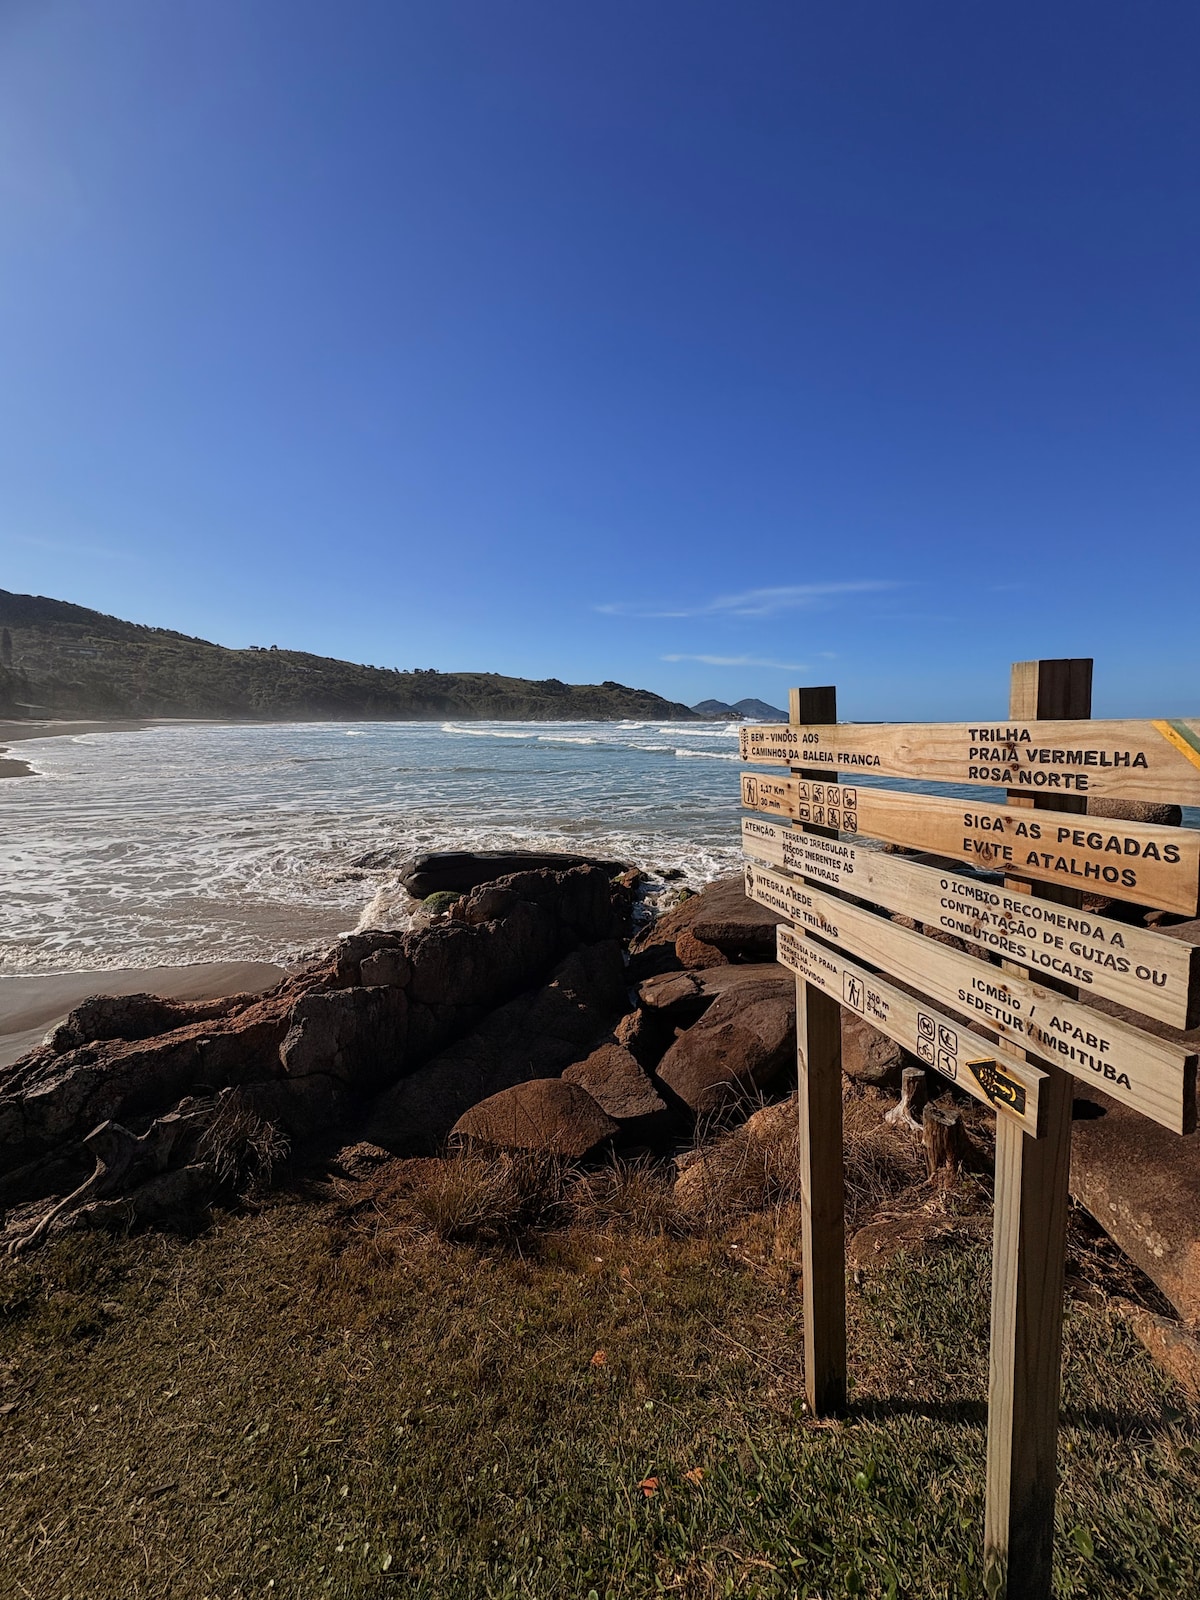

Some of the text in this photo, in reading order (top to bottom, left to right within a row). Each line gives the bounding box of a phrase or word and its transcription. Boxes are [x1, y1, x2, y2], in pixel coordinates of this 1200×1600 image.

[802, 734, 819, 743] AOS
[968, 729, 1032, 742] TRILHA
[752, 748, 880, 766] CAMINHOS DA BALEIA FRANCA
[969, 748, 1148, 768] PRAIA VERMELHA
[760, 784, 784, 796] 1,17 Km
[968, 766, 1088, 790] ROSA NORTE
[760, 798, 780, 808] 30 min
[745, 822, 855, 860] ATENÇÃO: TERRENO IRREGULAR E
[964, 814, 1180, 864] SIGA AS PEGADAS
[782, 844, 854, 874] RISCOS INERENTES AS
[805, 864, 840, 882] NATURAIS
[963, 838, 1137, 888] EVITE ATALHOS
[756, 875, 812, 906] INTEGRA A REDE
[757, 889, 838, 937] NACIONAL DE TRILHAS
[940, 879, 1125, 949] O ICMBIO RECOMENDA A
[780, 934, 838, 974] TRAVESSIA DE PRAIA
[940, 898, 1168, 988] CONTRATAÇÃO DE GUIAS OU
[940, 916, 1094, 984] CONDUTORES LOCAIS
[867, 990, 890, 1011] 500 m
[873, 1007, 887, 1022] min
[972, 978, 1021, 1010] ICMBio
[1050, 1016, 1110, 1052] APABF
[958, 989, 1024, 1032] SEDETUR
[1038, 1029, 1132, 1090] IMBITUBA
